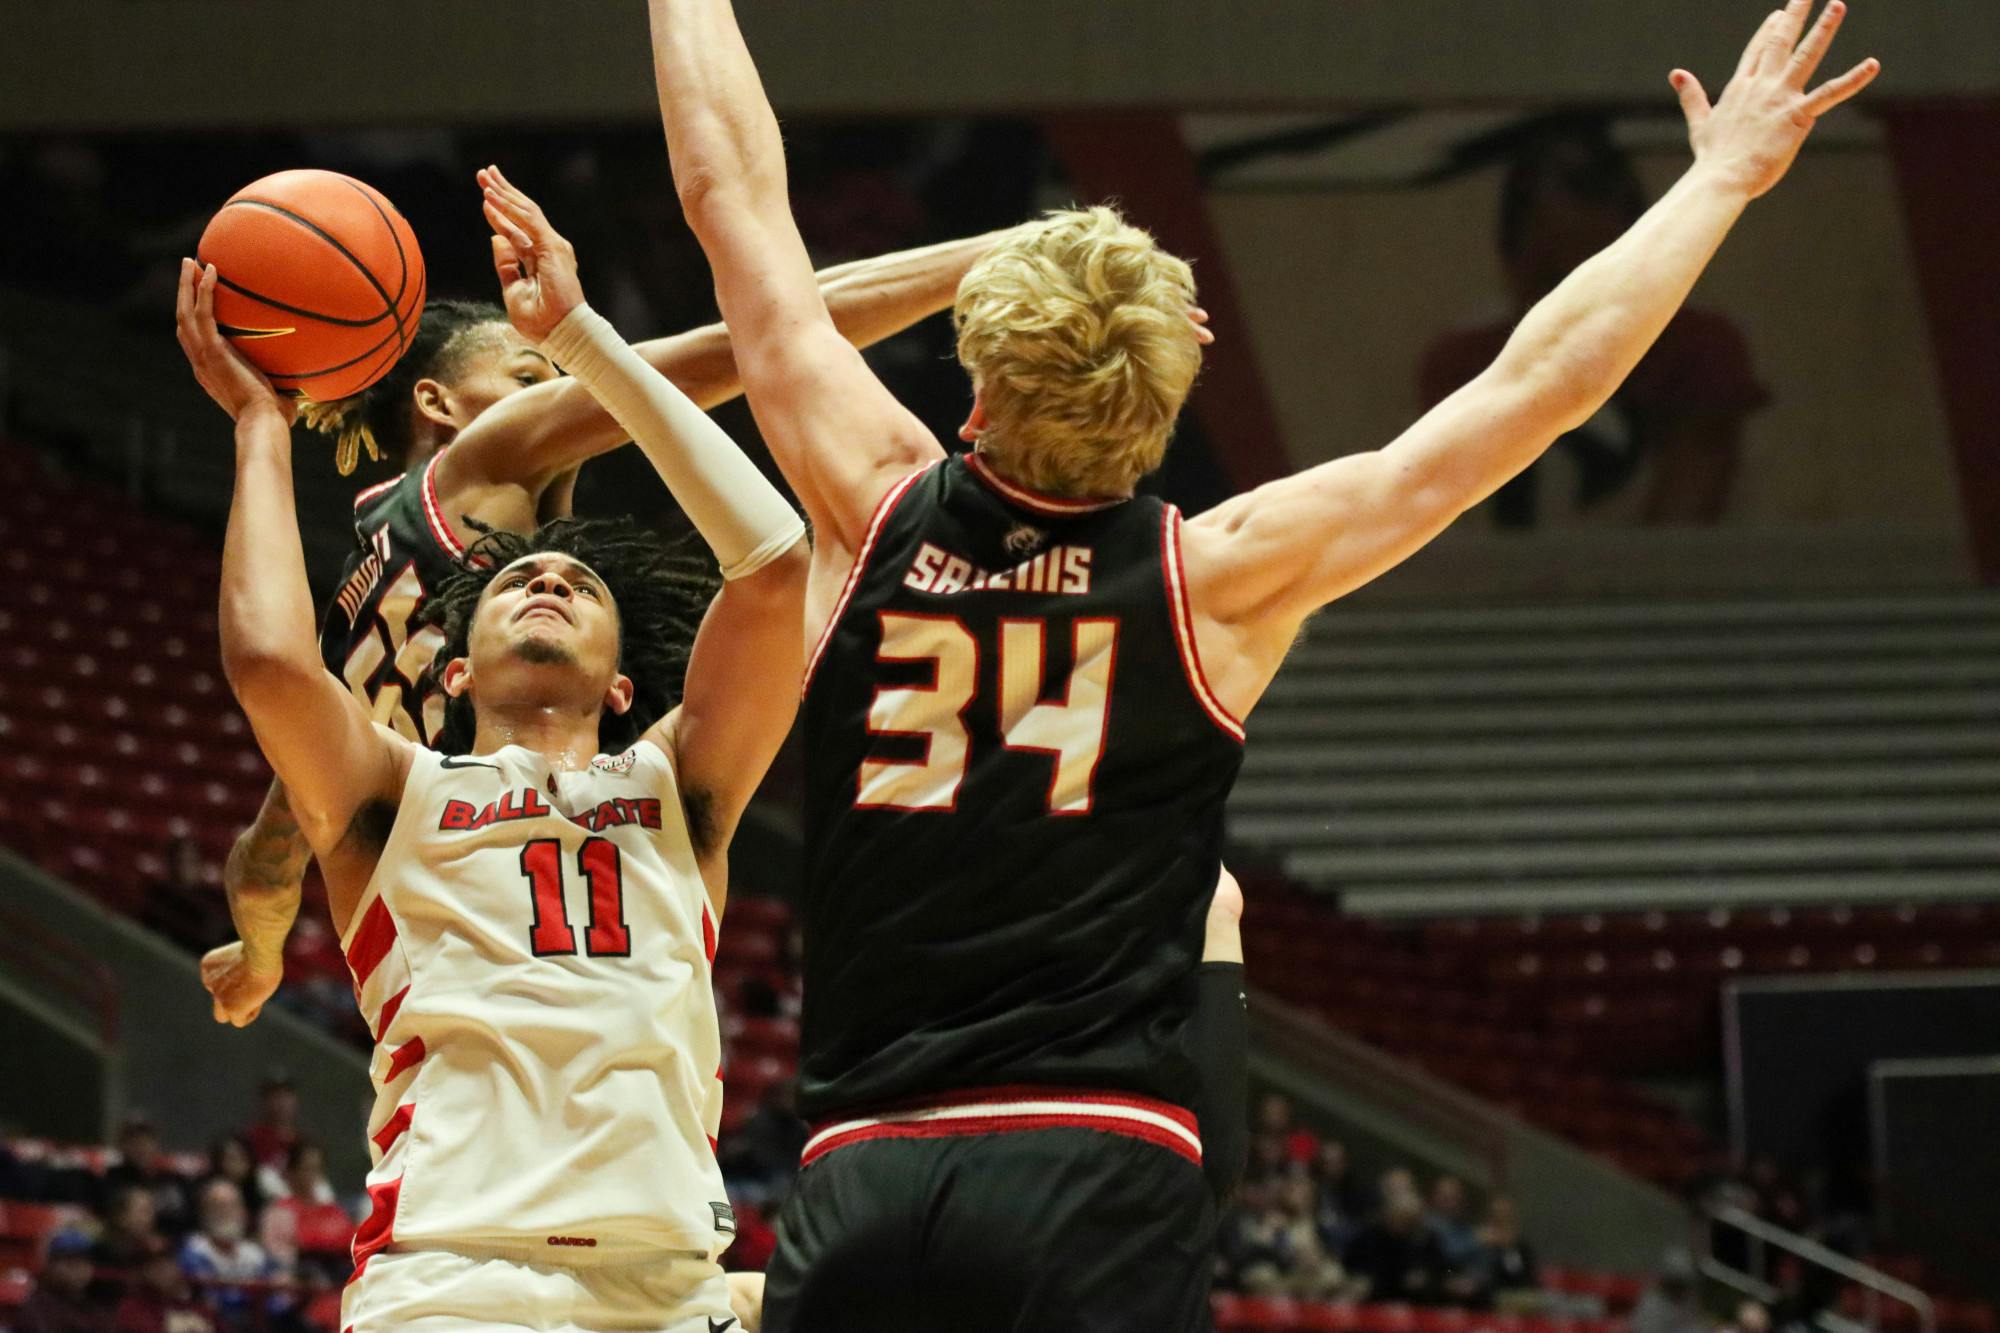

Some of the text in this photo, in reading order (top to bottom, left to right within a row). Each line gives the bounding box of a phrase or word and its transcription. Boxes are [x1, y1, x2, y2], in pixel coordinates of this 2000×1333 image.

[853, 610, 1120, 815] 34
[439, 787, 662, 833] BALL TATE
[520, 836, 631, 957] 11
